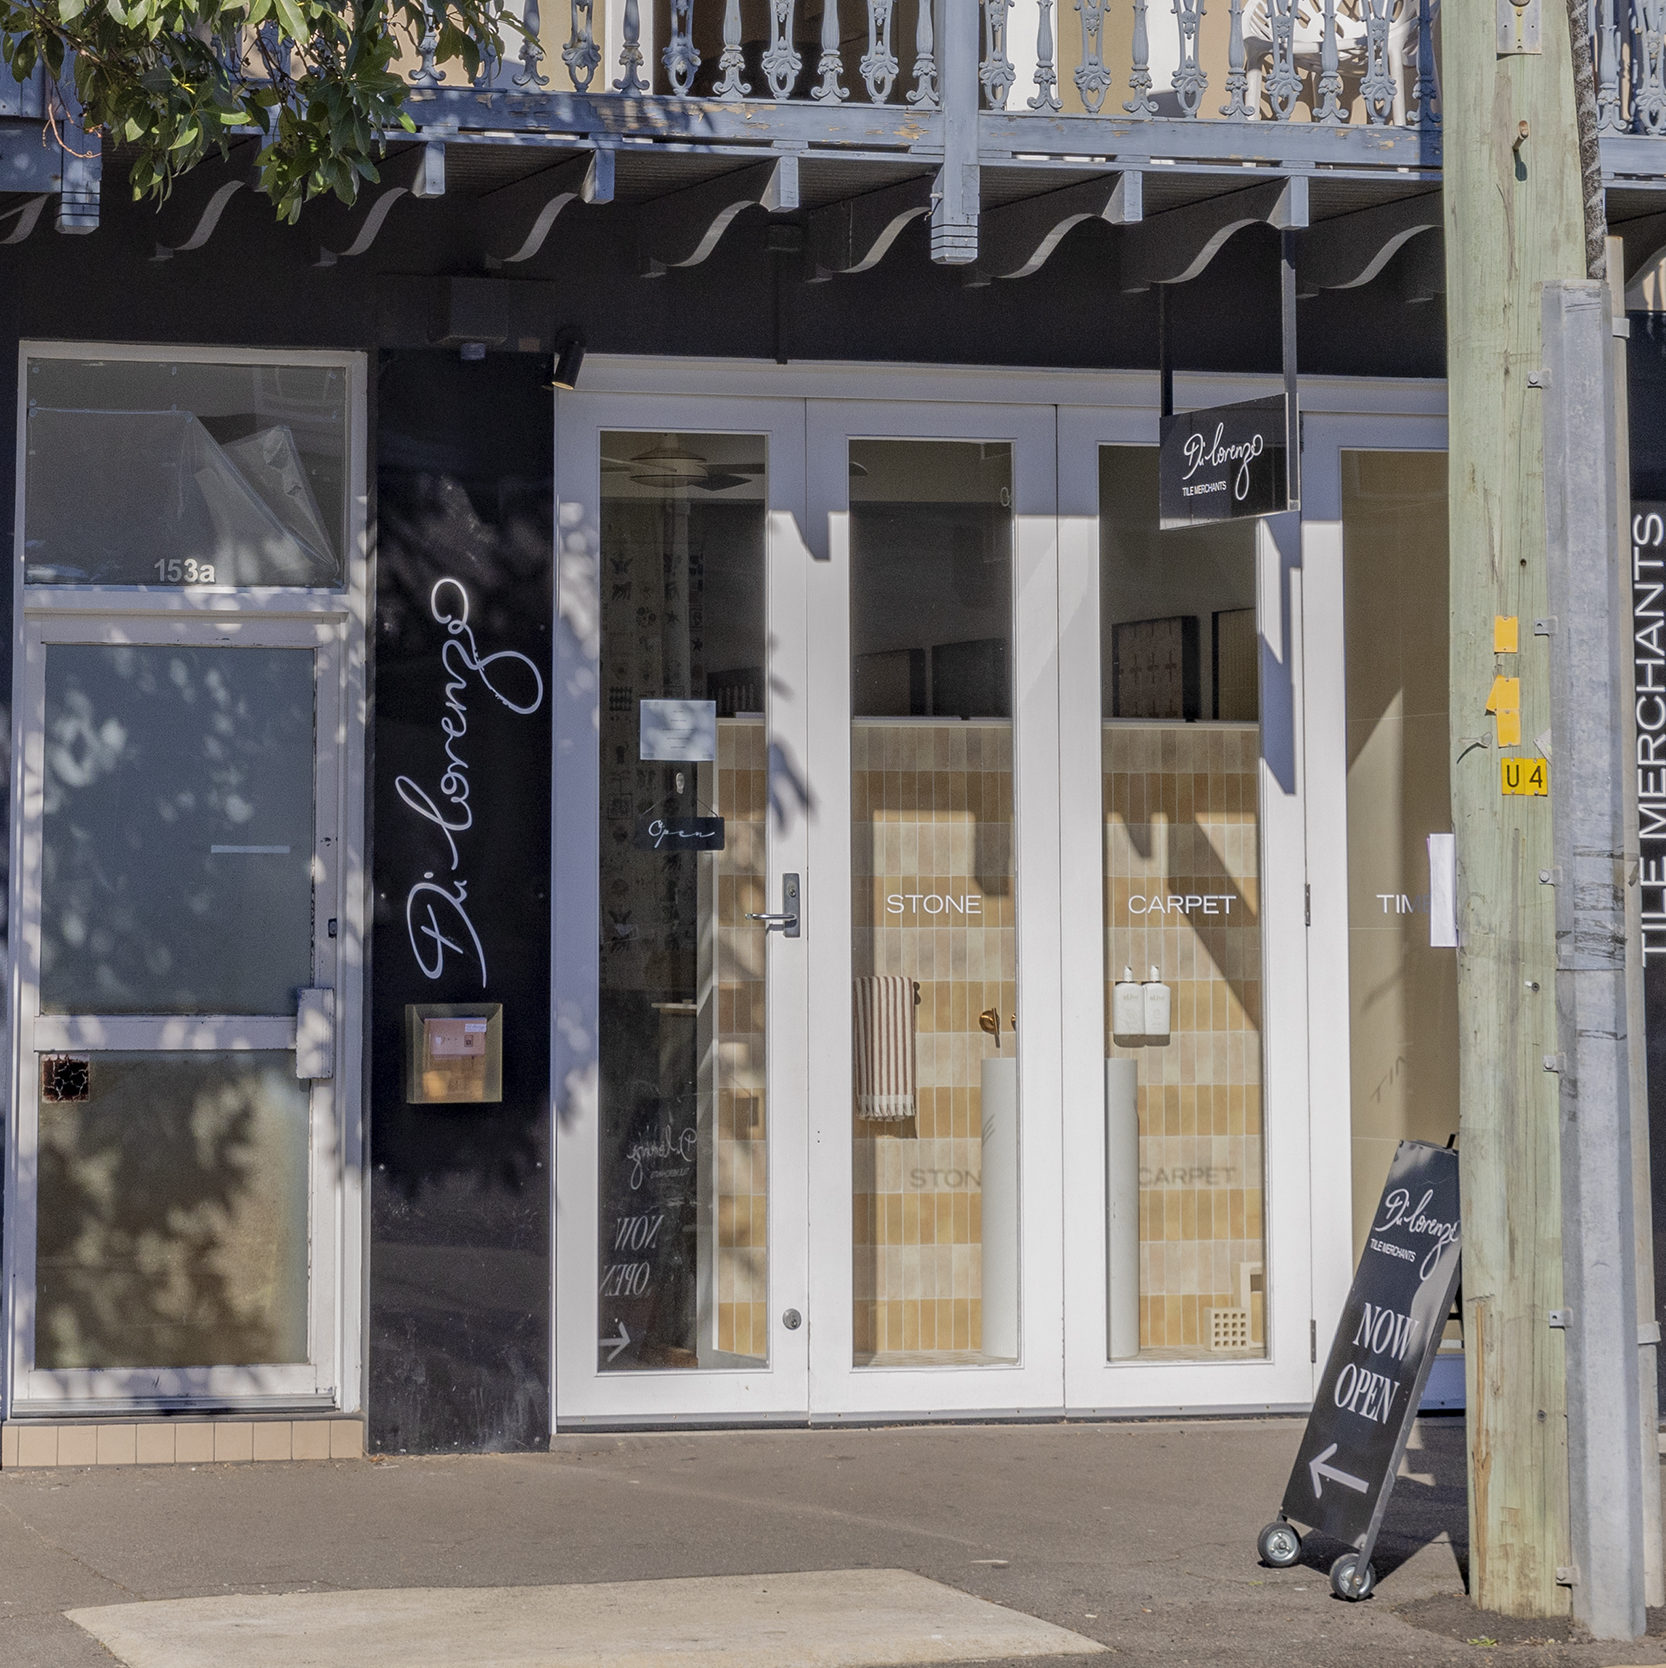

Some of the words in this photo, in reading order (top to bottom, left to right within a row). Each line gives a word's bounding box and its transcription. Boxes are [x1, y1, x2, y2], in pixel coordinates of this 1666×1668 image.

[1182, 487, 1194, 496] TILE
[1194, 481, 1227, 495] MERCHANTS
[154, 559, 215, 583] 153a
[886, 894, 983, 914] STONE
[1128, 894, 1237, 915] CARPET
[1370, 1238, 1382, 1252] TILE
[1381, 1242, 1417, 1263] MERCHANTS
[1352, 1302, 1421, 1362] NOW
[1334, 1363, 1401, 1425] OPEN
